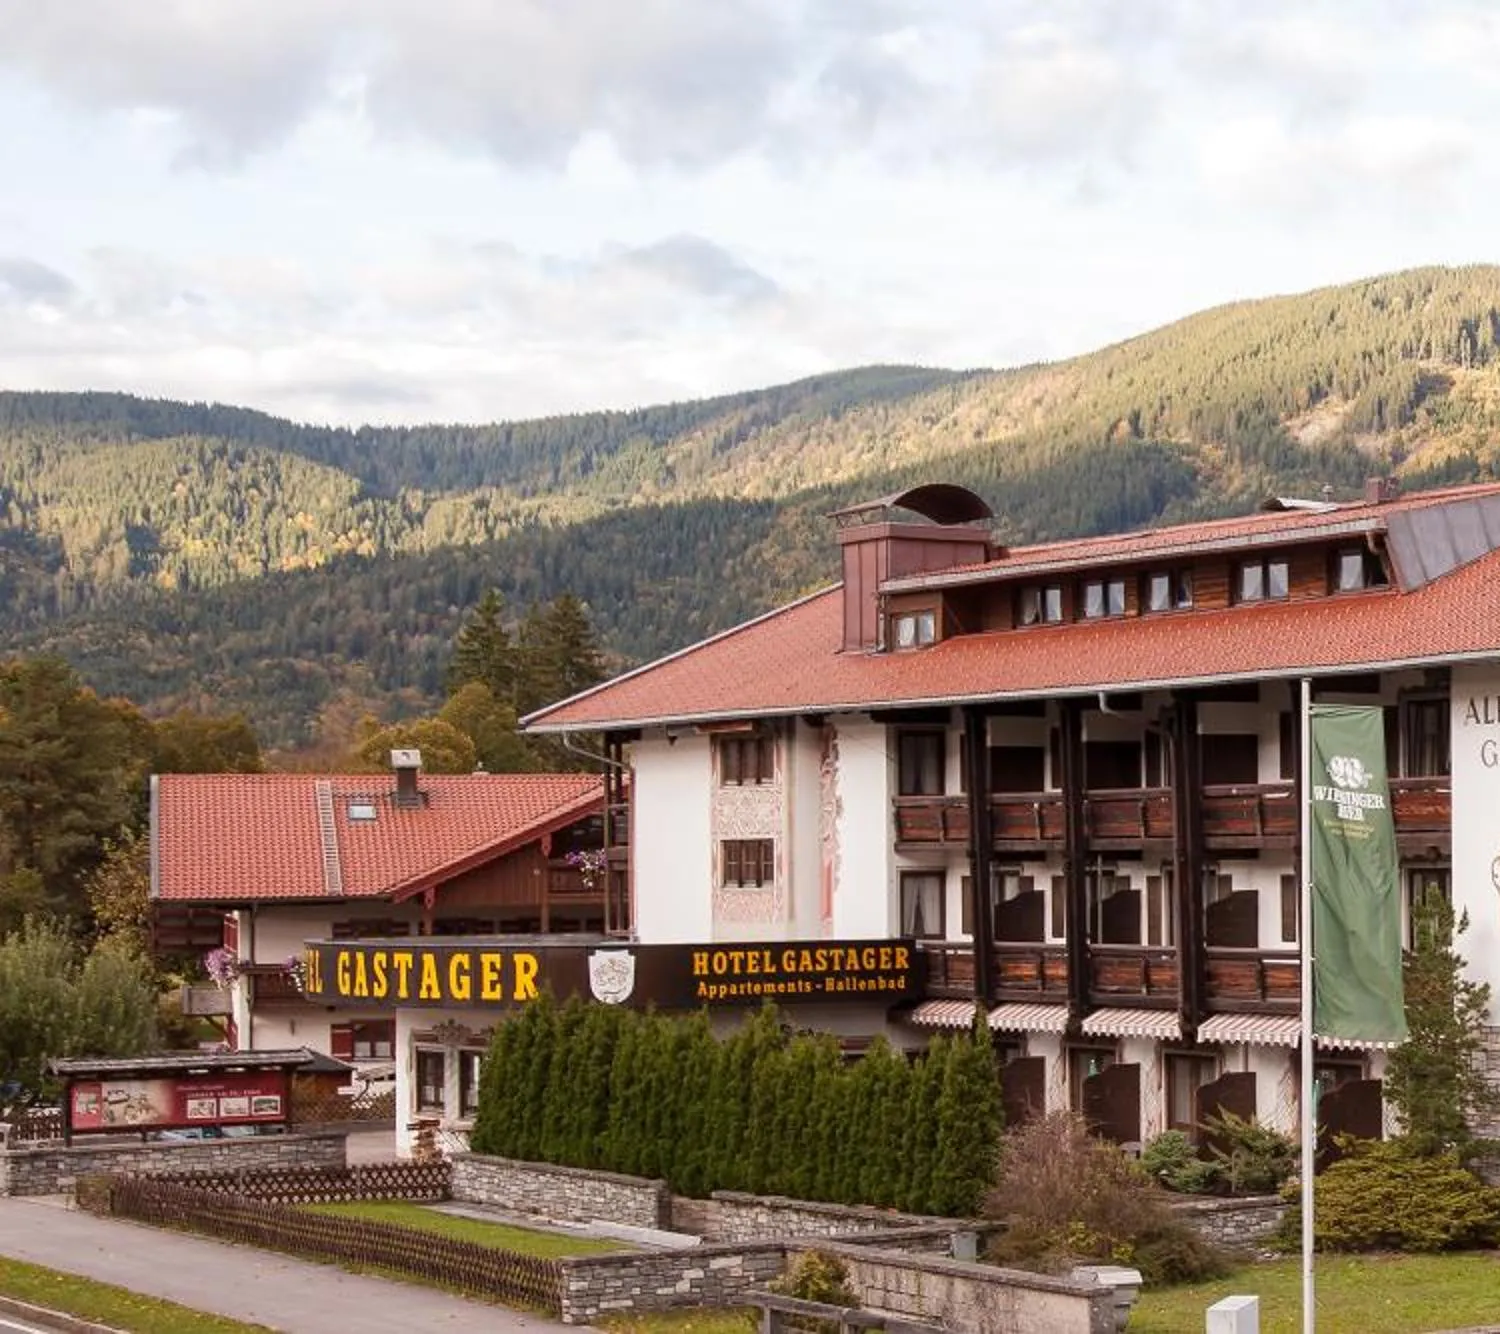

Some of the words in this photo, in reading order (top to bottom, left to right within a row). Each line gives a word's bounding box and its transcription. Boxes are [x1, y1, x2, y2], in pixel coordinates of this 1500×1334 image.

[693, 951, 777, 975] HOTEL
[783, 947, 910, 972] GASTAGER
[337, 951, 540, 1001] GASTAGER
[697, 979, 812, 998] Appartements
[825, 975, 906, 992] Hallenbad
